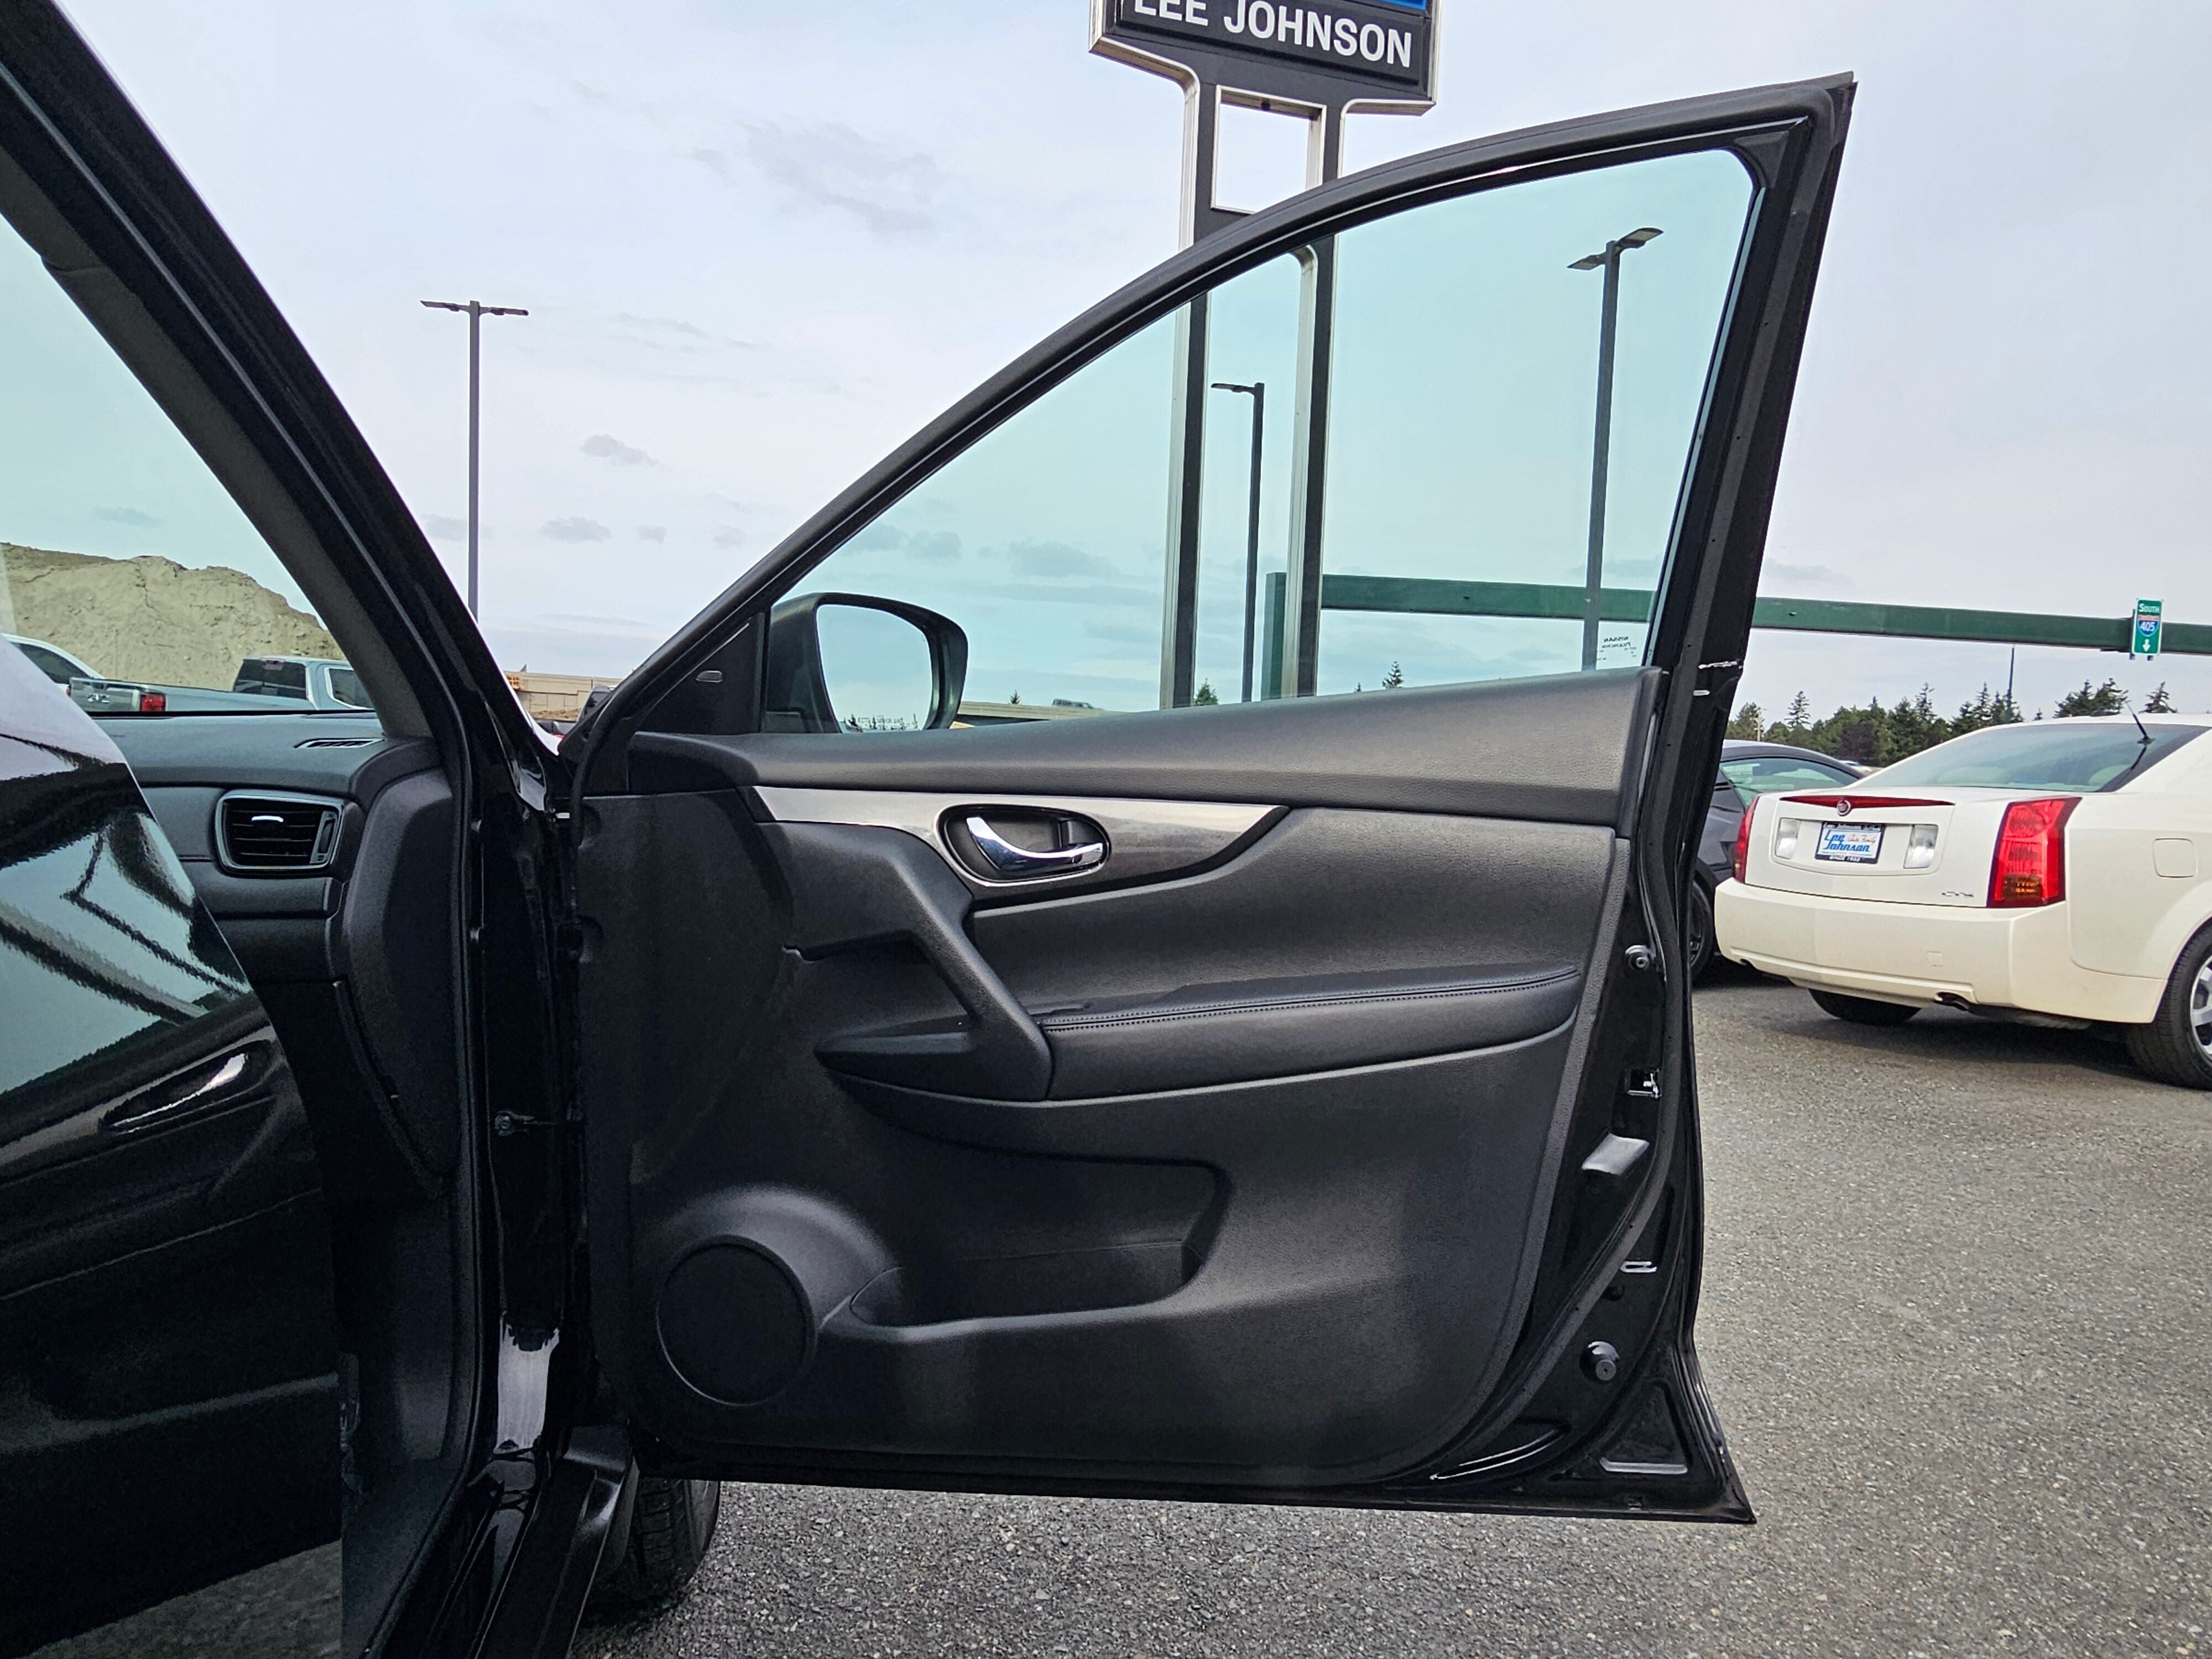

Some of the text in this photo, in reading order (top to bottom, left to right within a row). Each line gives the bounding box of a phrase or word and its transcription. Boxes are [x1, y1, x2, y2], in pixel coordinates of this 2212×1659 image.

[1223, 0, 1412, 67] JOHNSON
[2140, 622, 2156, 632] 405
[1824, 830, 1845, 842] Lee
[1823, 838, 1870, 852] Johnson
